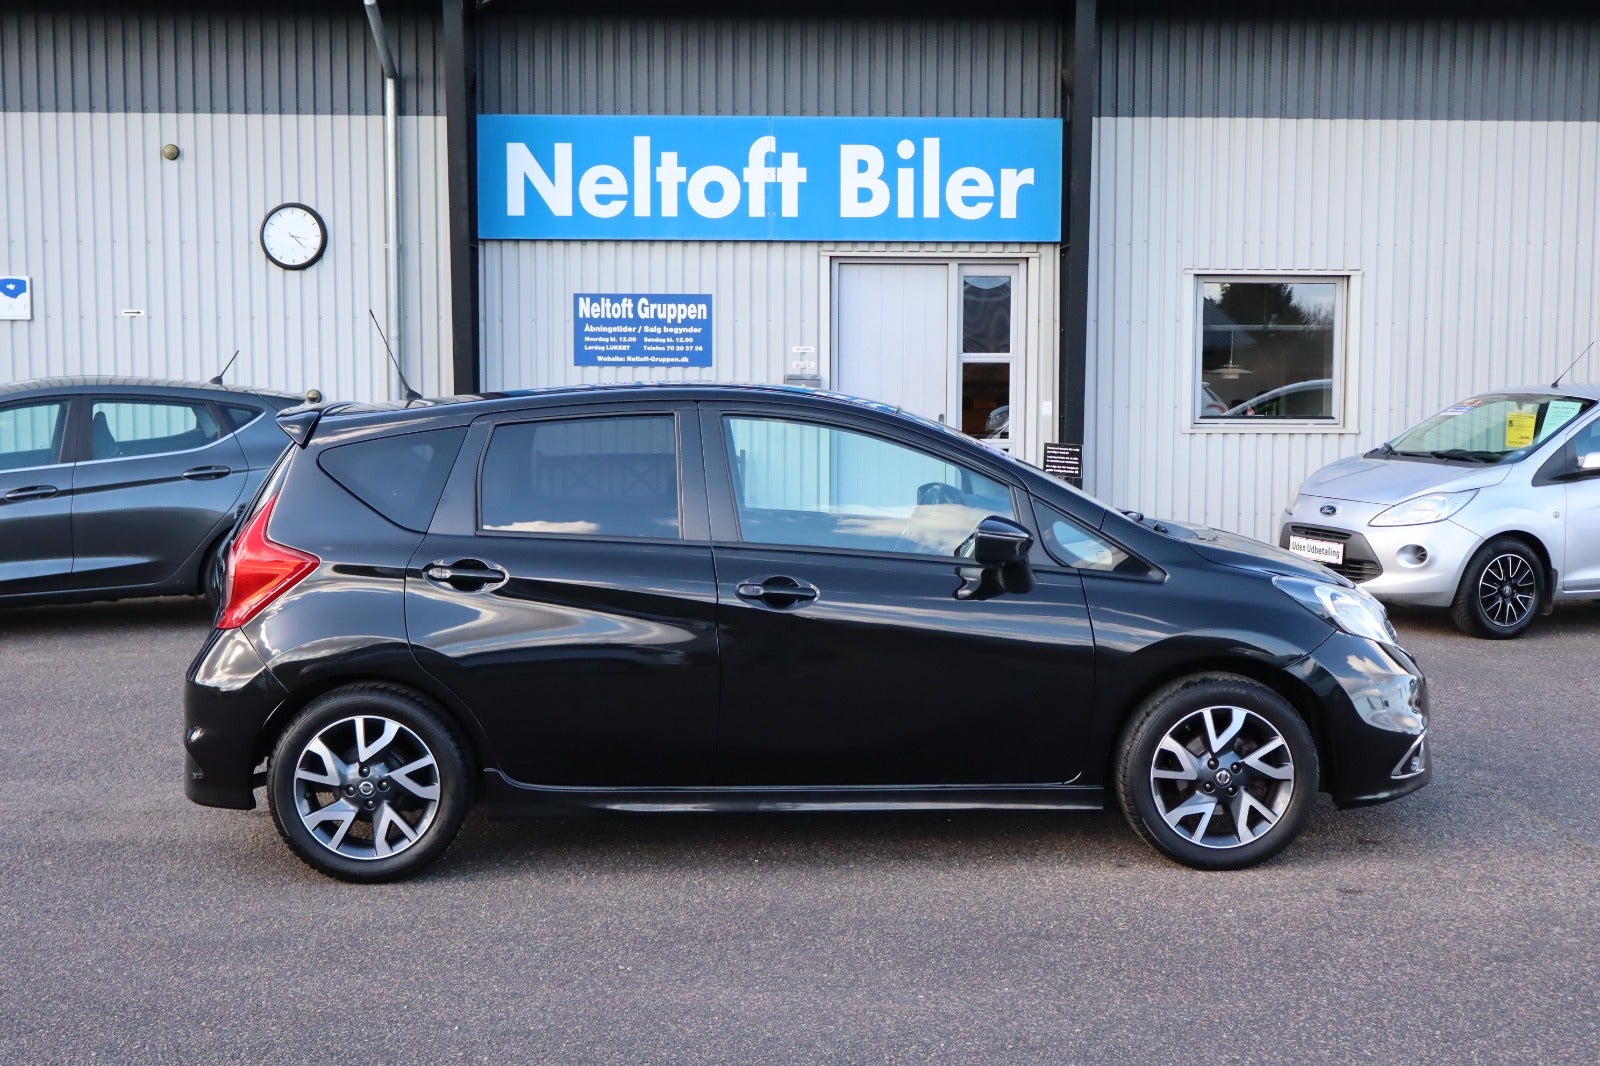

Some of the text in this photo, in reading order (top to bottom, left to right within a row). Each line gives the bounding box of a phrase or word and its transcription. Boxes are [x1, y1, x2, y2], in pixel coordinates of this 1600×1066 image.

[506, 135, 1035, 220] Neltoft Biler
[578, 297, 708, 324] Neltoft Gruppen
[584, 323, 637, 333] Åbningstider
[643, 325, 662, 334] Salg
[663, 325, 703, 334] begynder
[1291, 541, 1341, 560] Uden Udbetaling
